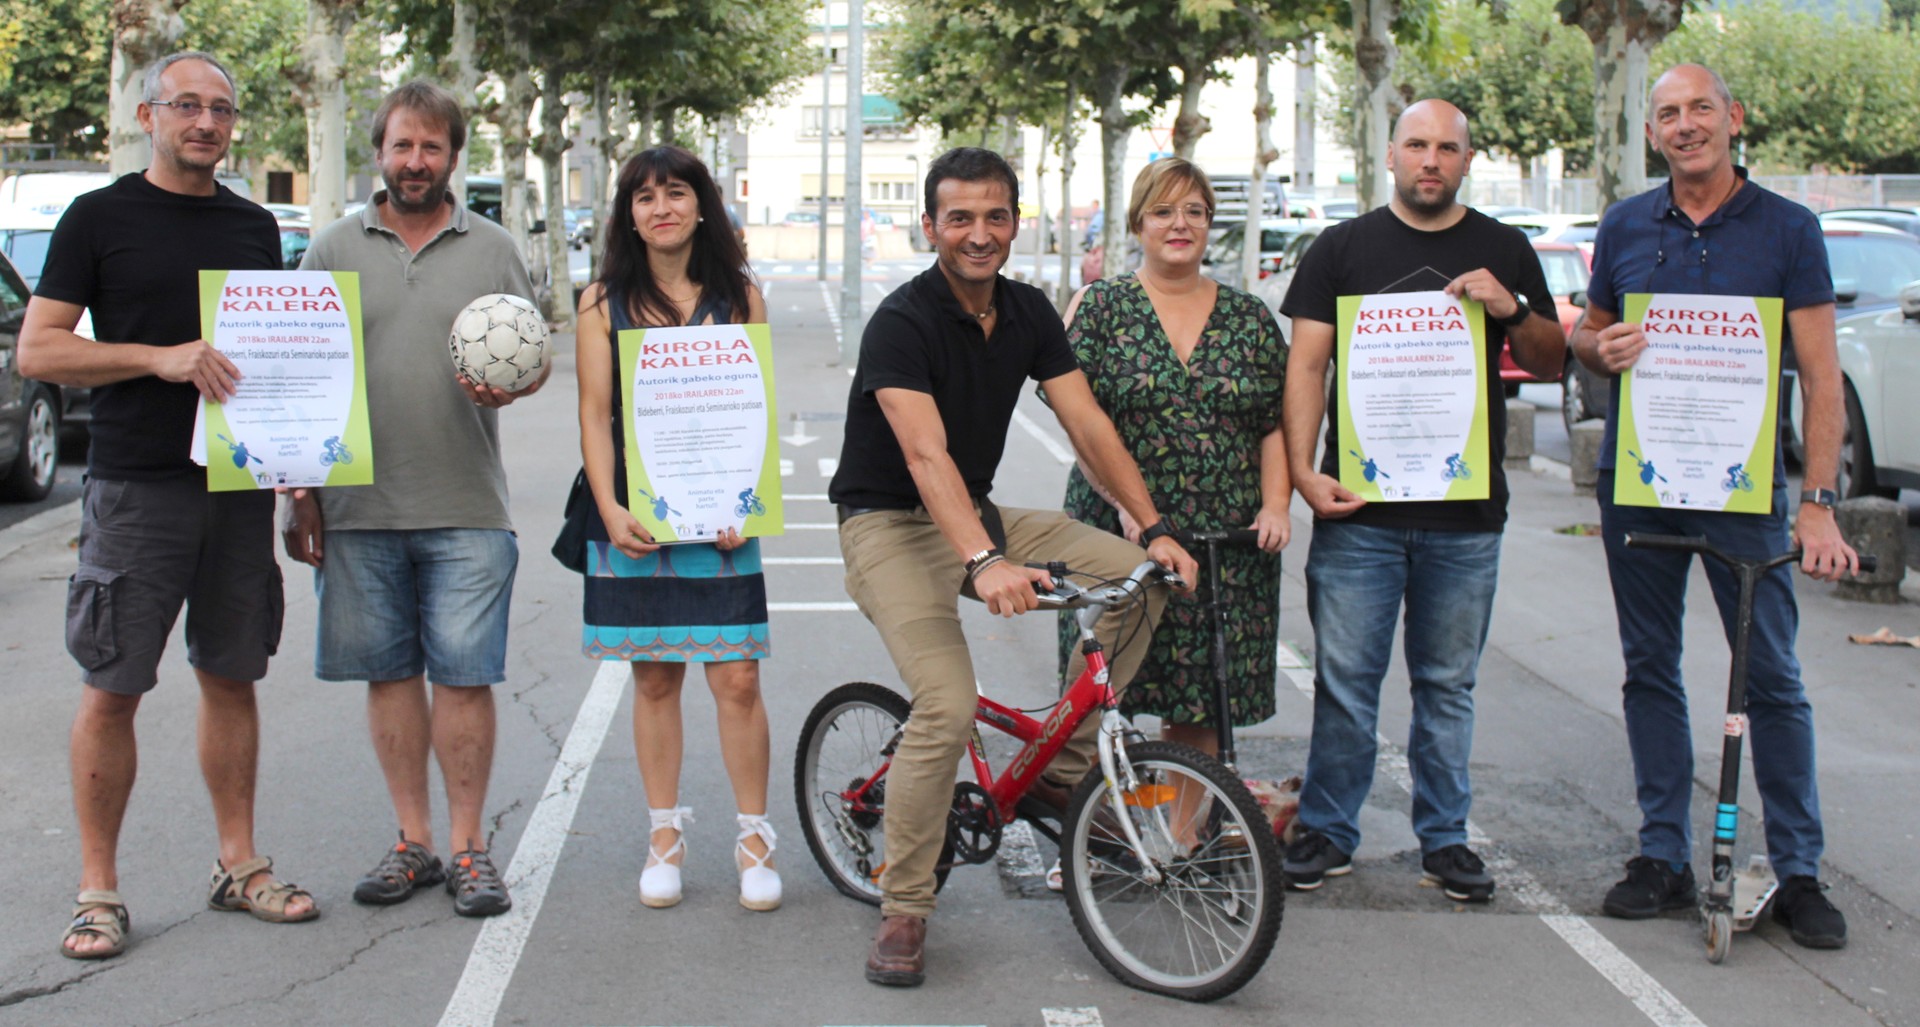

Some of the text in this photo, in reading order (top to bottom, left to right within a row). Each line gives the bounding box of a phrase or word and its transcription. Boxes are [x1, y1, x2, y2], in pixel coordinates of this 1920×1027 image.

[225, 286, 337, 297] KIROLA
[222, 300, 341, 312] KALERA
[1360, 306, 1462, 320] KIROLA
[1648, 309, 1758, 324] KIROLA
[219, 320, 262, 328] Autorik
[265, 320, 307, 329] gabeko
[1357, 320, 1465, 334] KALERA
[1645, 323, 1760, 338] KALERA
[643, 339, 749, 354] KIROLA
[1353, 342, 1391, 350] Autorik
[1394, 341, 1433, 350] gabeko
[1684, 343, 1725, 353] gabeko
[1728, 346, 1763, 355] eguna
[281, 351, 290, 359] eta
[291, 349, 326, 359] Seminarioko
[327, 350, 349, 360] patioan
[641, 353, 753, 369] KALERA
[1655, 357, 1746, 369] 2018ko IRAILAREN 22an
[638, 373, 758, 386] Autorik gabeko eguna
[1407, 370, 1416, 378] eta
[1696, 373, 1704, 382] eta
[655, 392, 682, 400] 2018ko
[684, 390, 724, 398] IRAILAREN
[696, 405, 706, 413] eta
[706, 402, 741, 412] Seminarioko
[741, 401, 762, 410] patioan
[1012, 699, 1073, 780] CONOR
